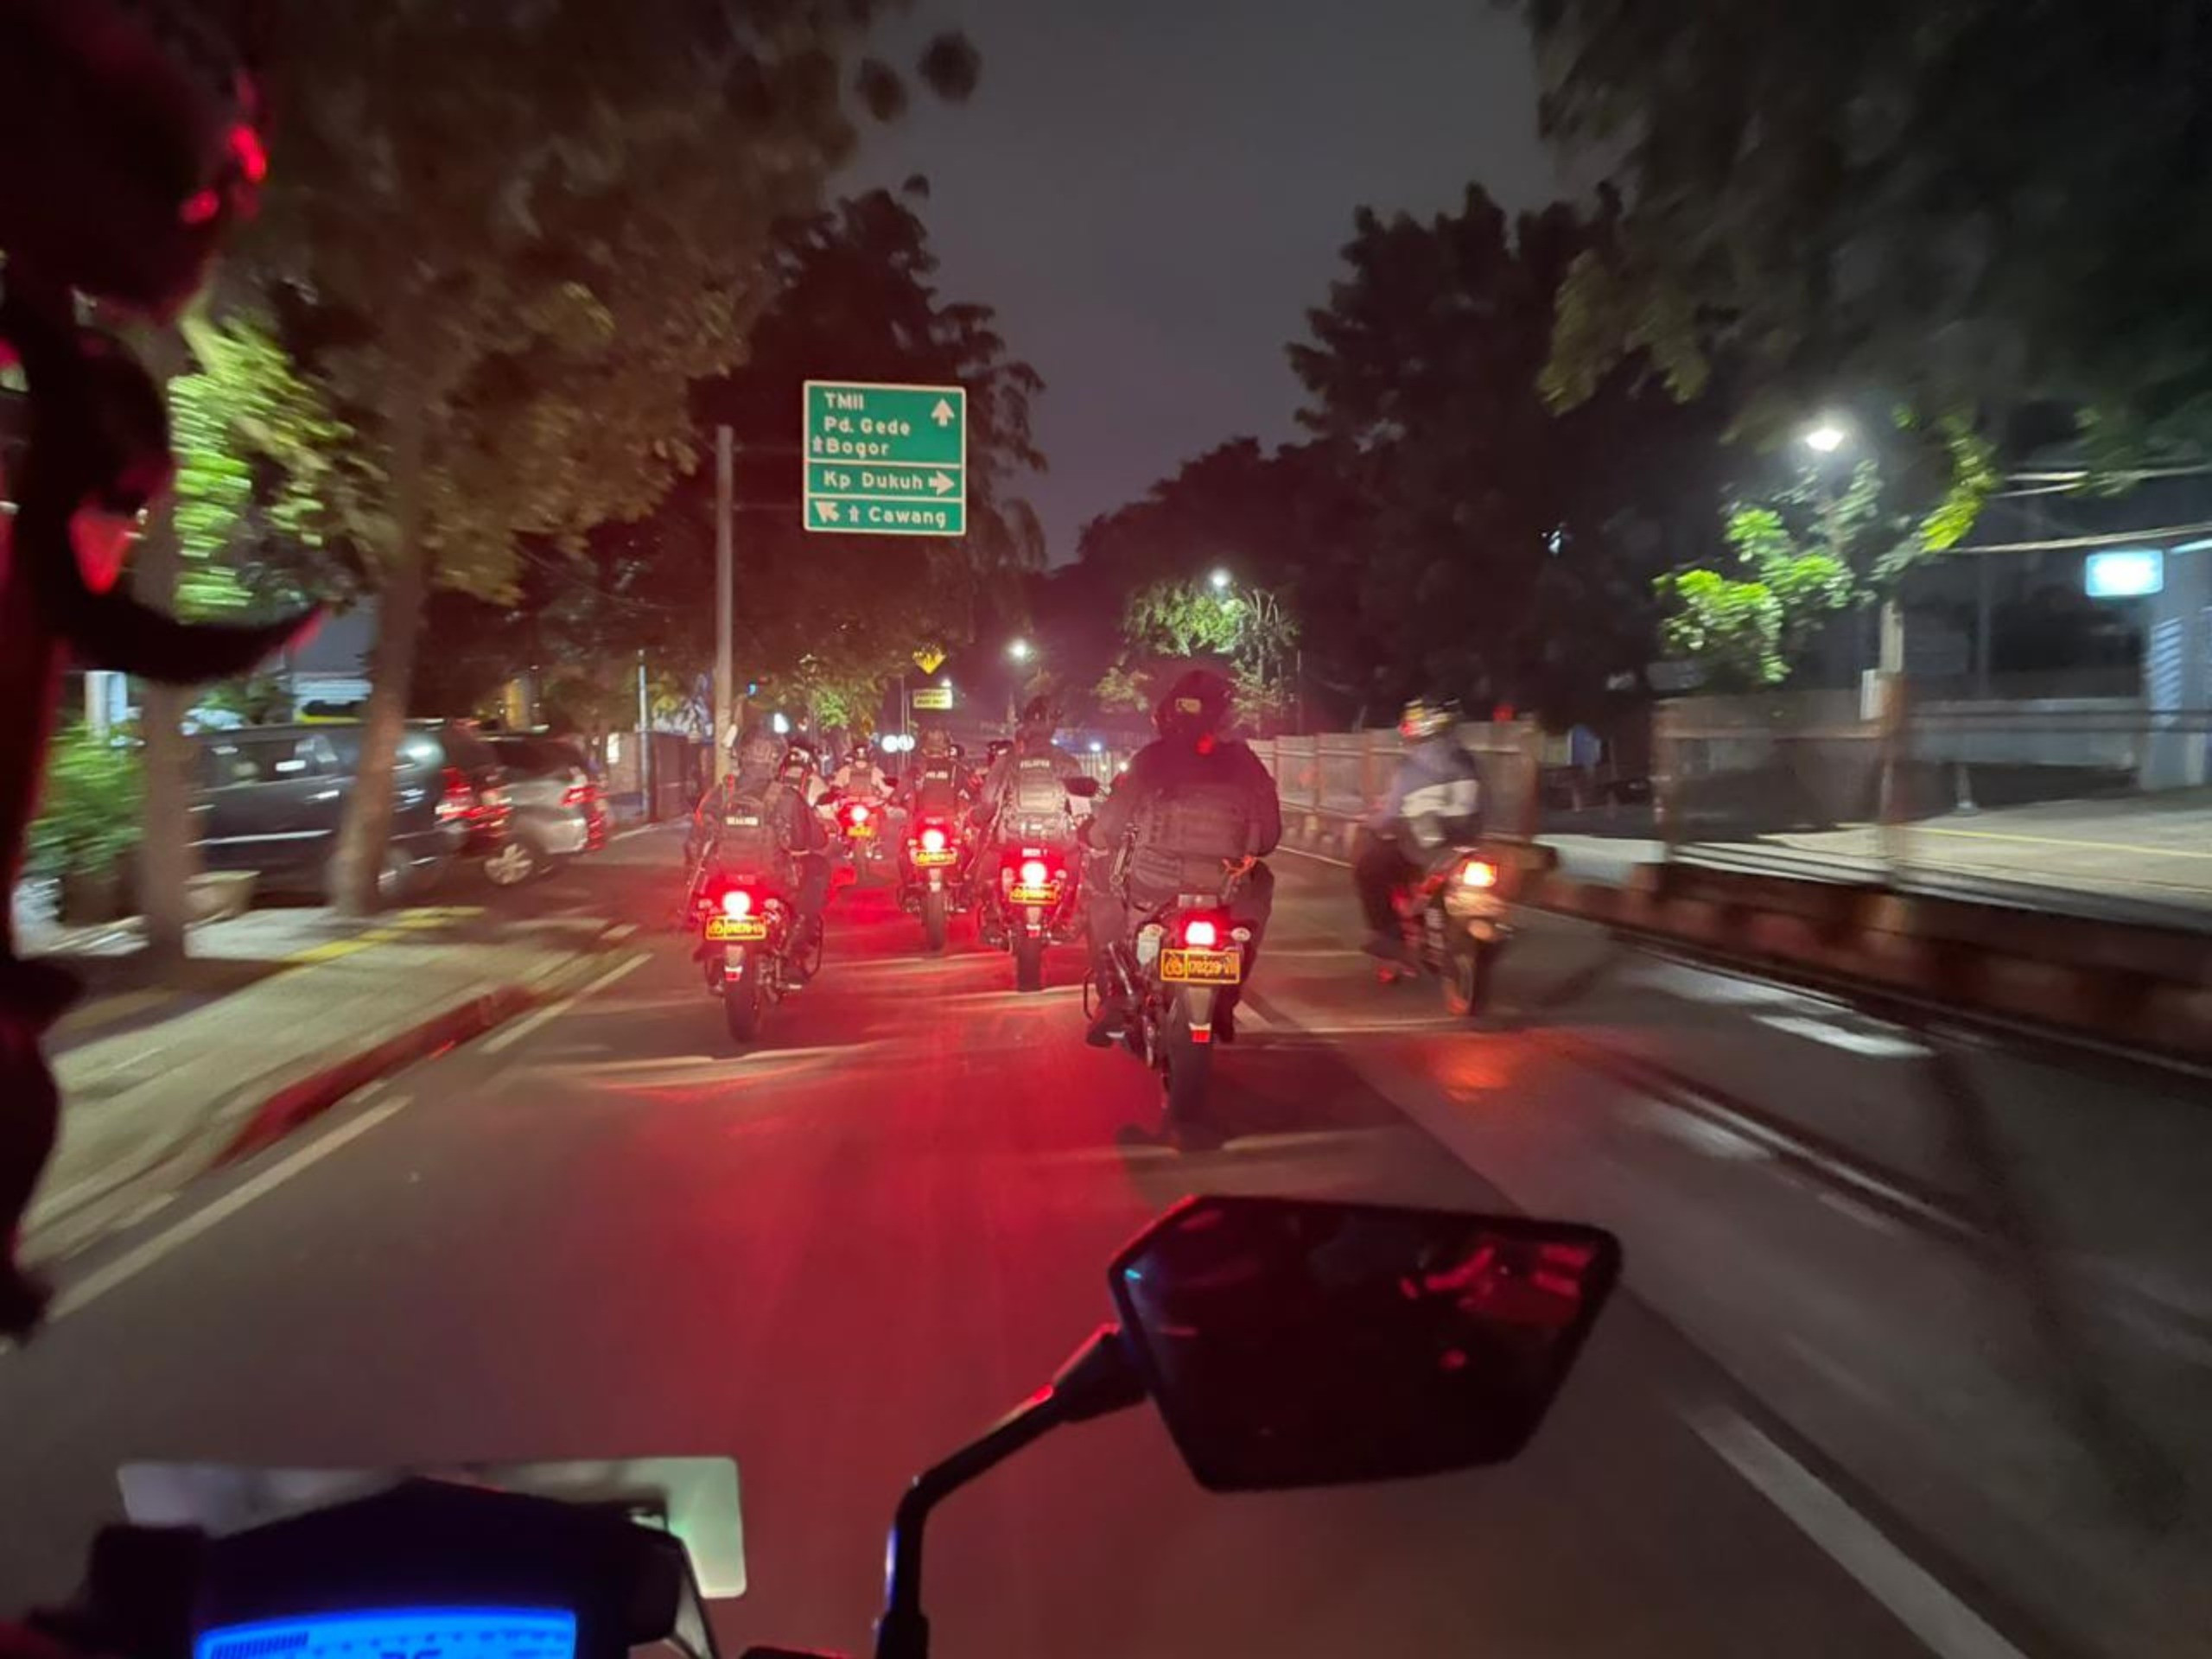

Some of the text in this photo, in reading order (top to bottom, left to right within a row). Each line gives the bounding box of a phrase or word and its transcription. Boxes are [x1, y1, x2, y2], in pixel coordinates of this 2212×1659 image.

[824, 391, 864, 410] TMII
[824, 416, 911, 435] Pd. Gede
[826, 437, 889, 458] Bogor
[823, 470, 923, 490] Kp Dukuh
[868, 505, 946, 529] Cawang
